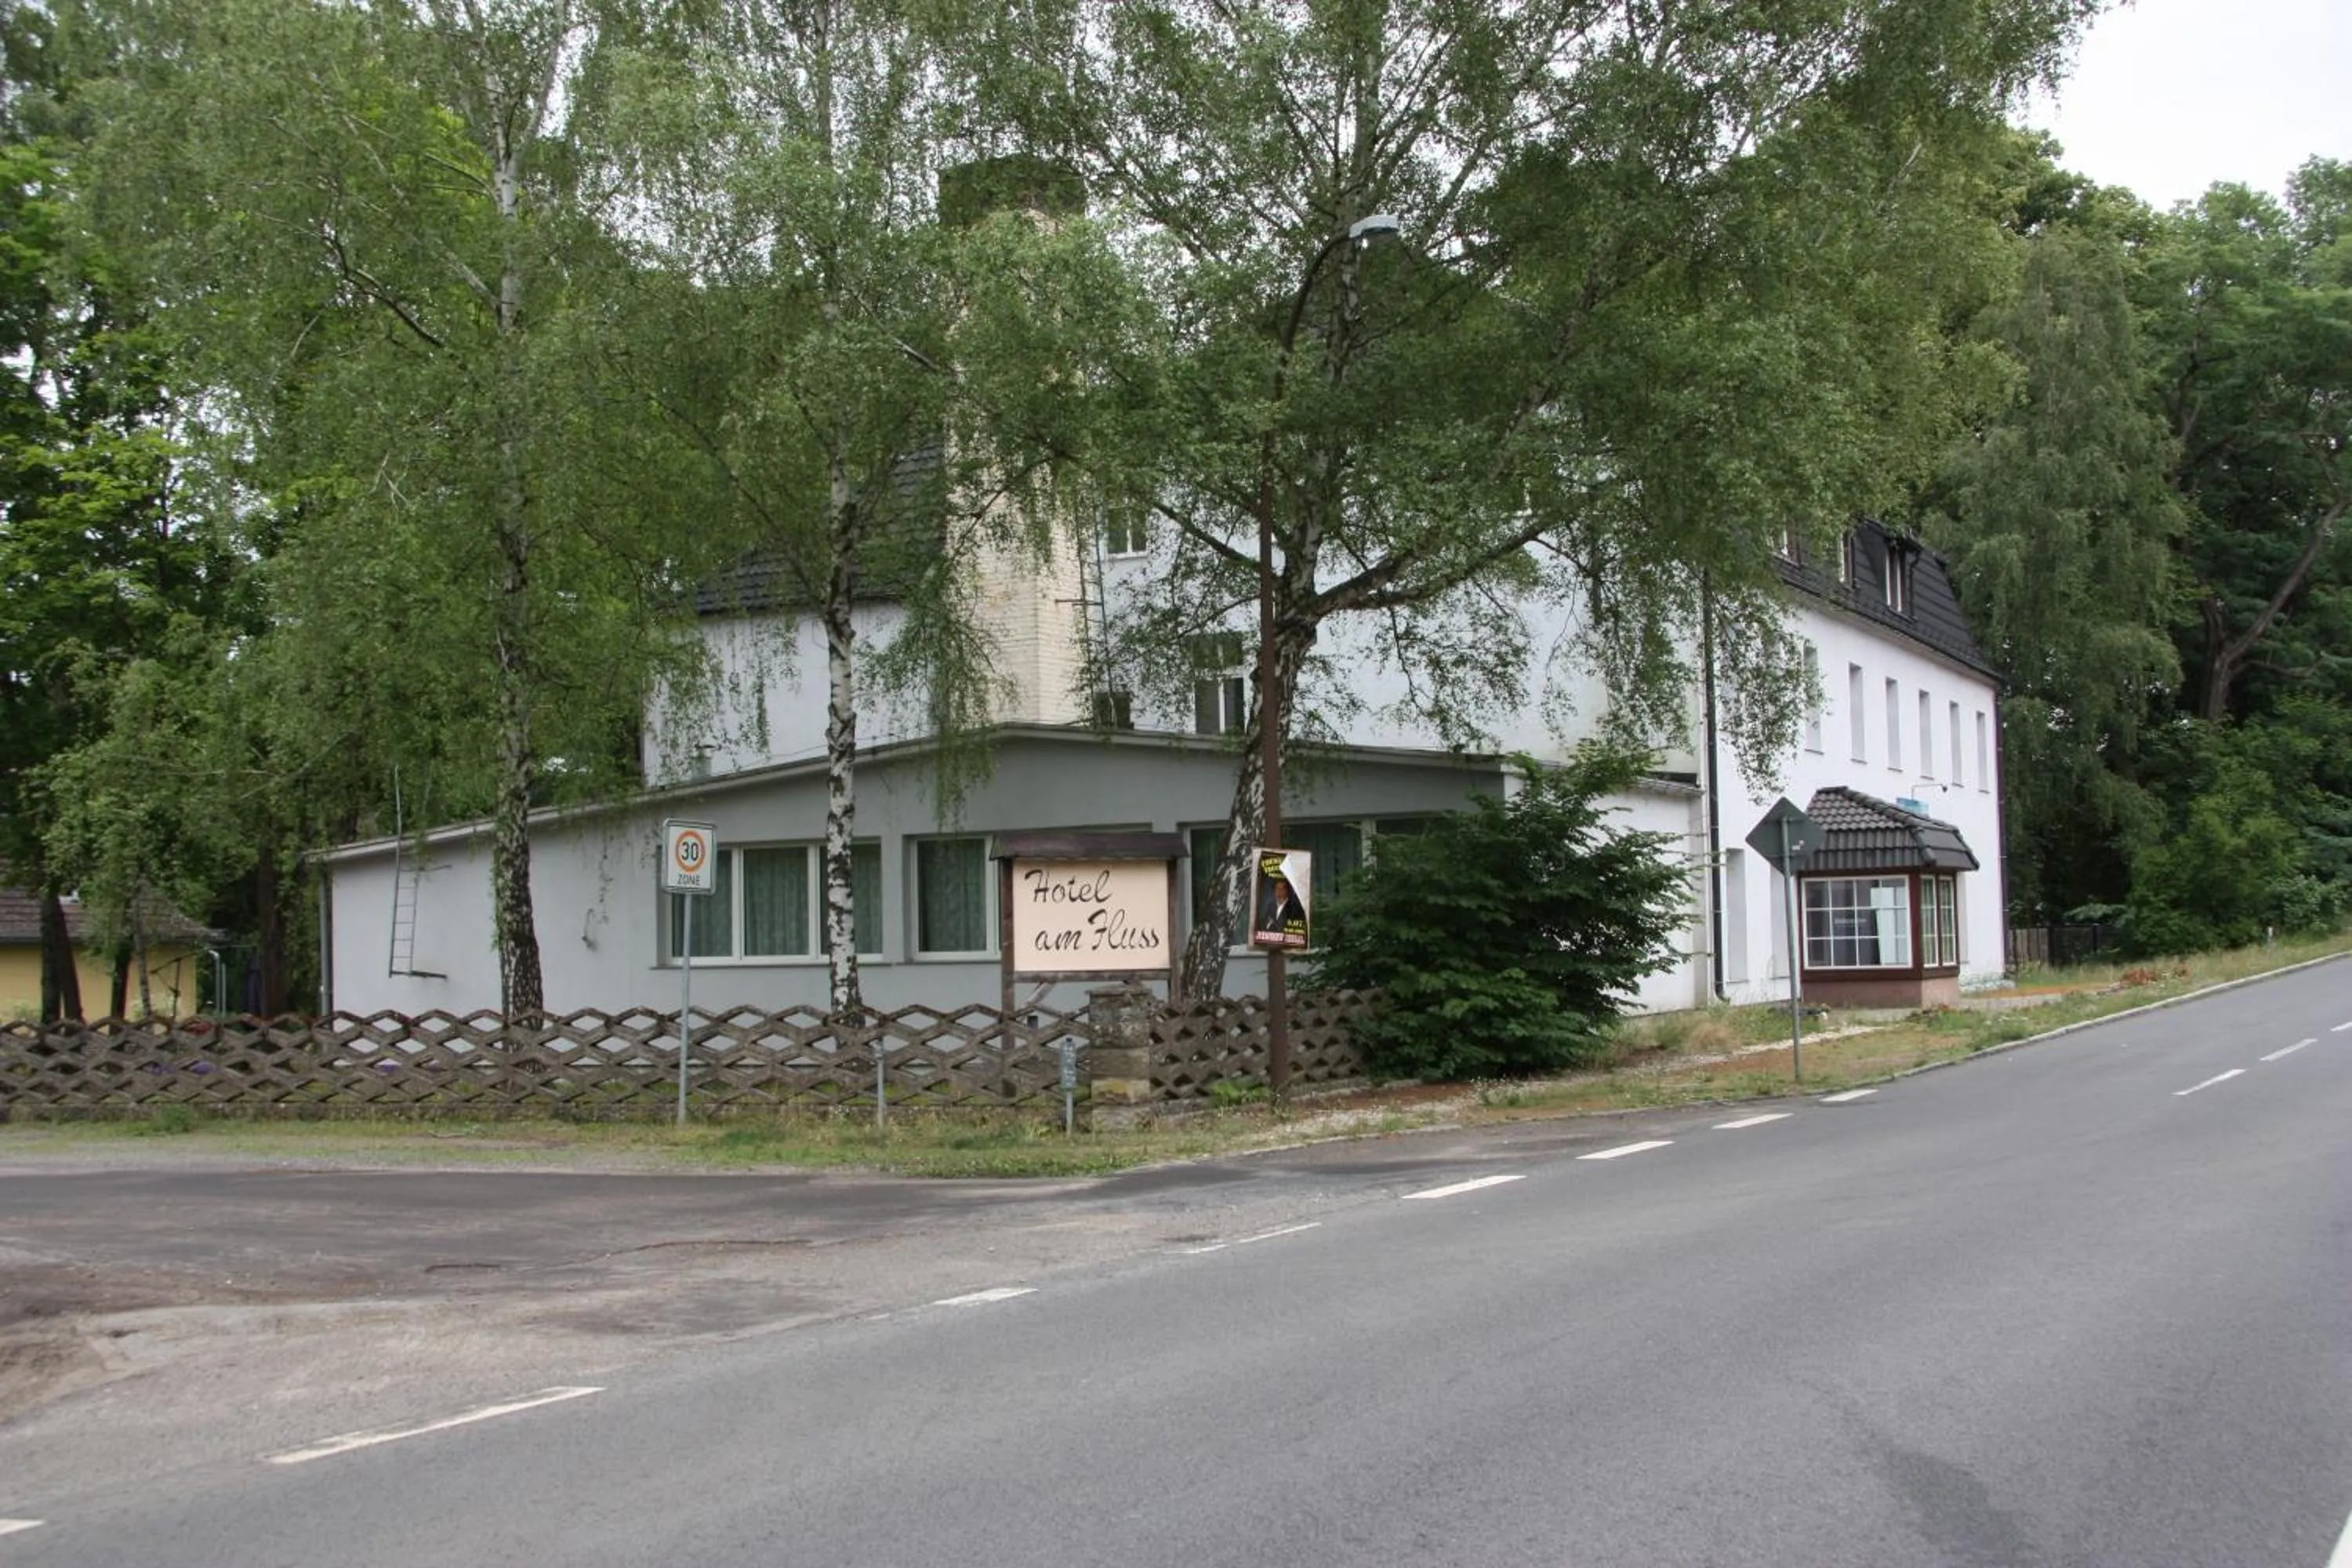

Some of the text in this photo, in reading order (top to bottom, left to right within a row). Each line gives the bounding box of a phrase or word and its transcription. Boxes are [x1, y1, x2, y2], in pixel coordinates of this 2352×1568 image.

[681, 841, 699, 862] 30
[677, 874, 701, 886] ZONE
[1024, 869, 1112, 903] Hotel
[1035, 908, 1160, 951] am Fluss
